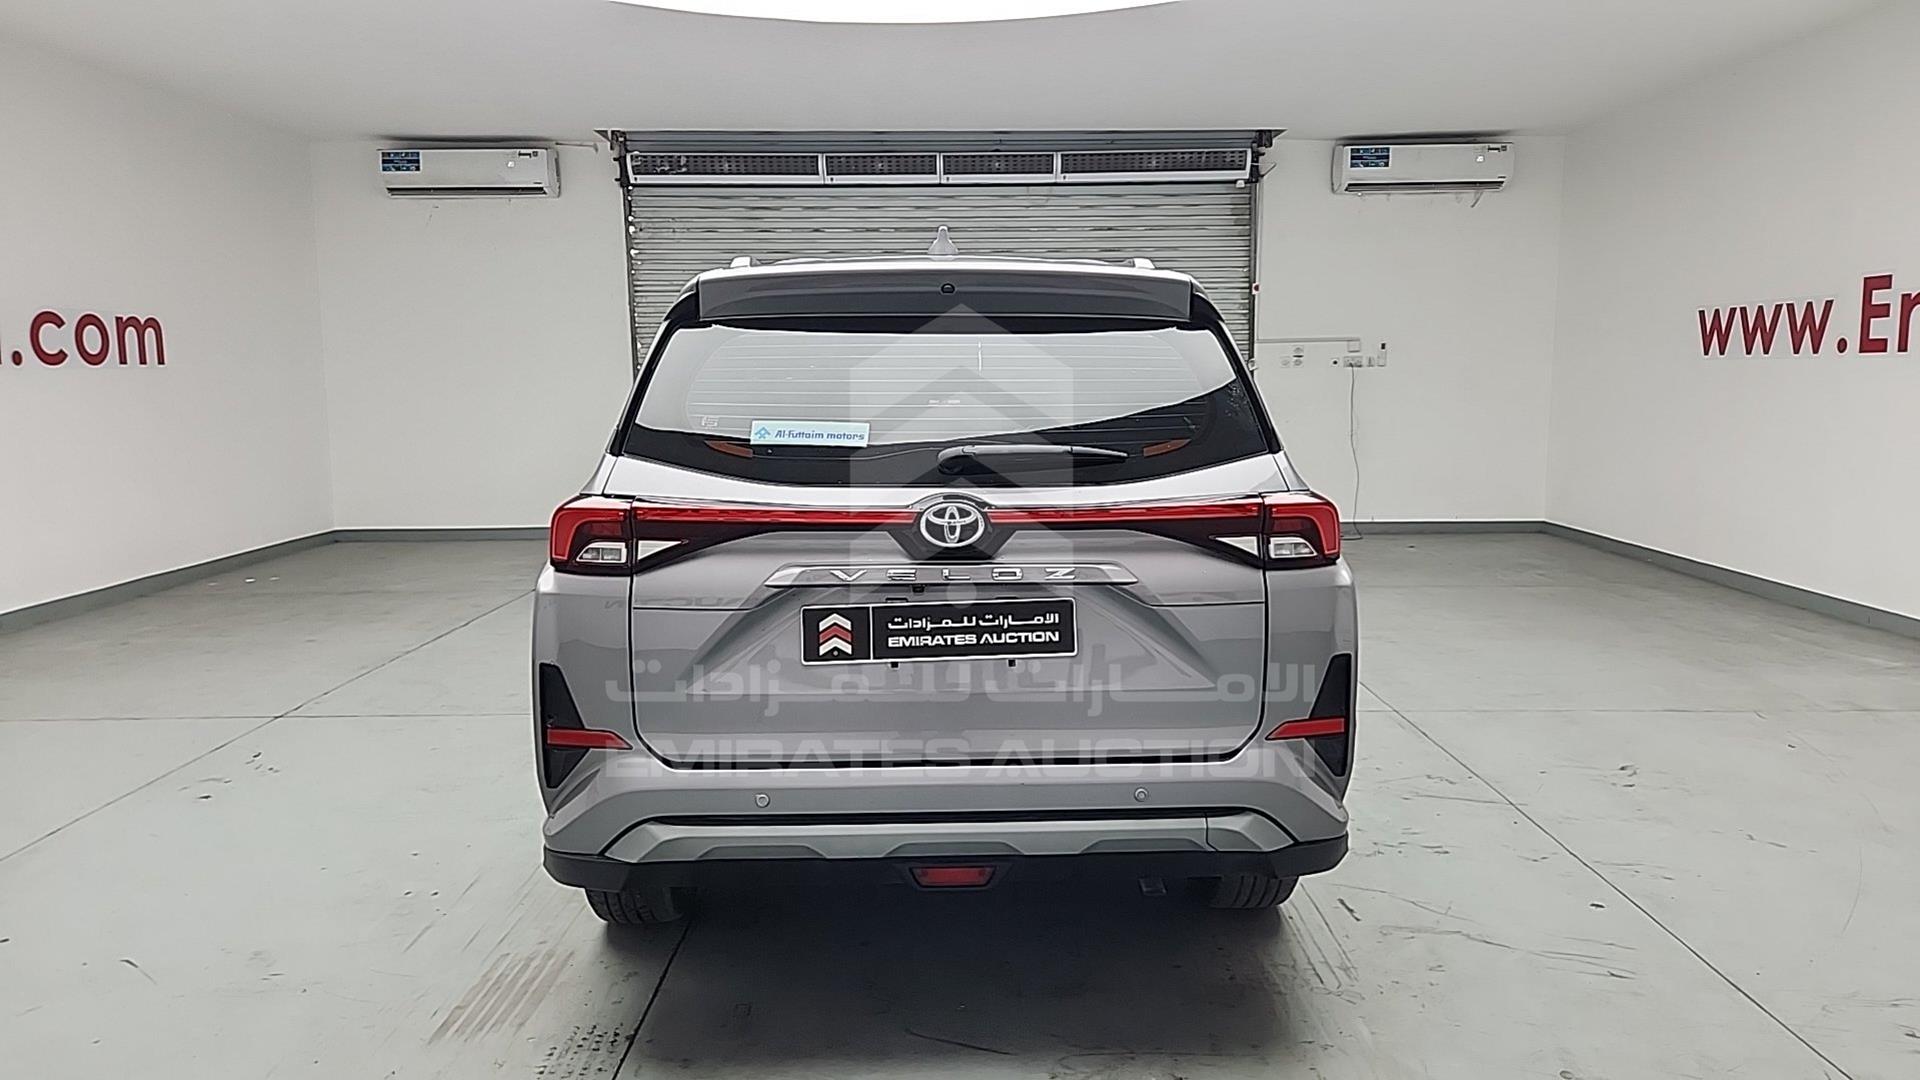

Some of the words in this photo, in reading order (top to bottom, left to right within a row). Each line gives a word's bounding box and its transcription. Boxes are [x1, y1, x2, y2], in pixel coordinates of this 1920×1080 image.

[0, 310, 166, 366] .com
[826, 432, 865, 441] motors
[830, 567, 1076, 582] VELOZ
[888, 634, 977, 648] EMIRATES
[979, 631, 1060, 645] AUCTION
